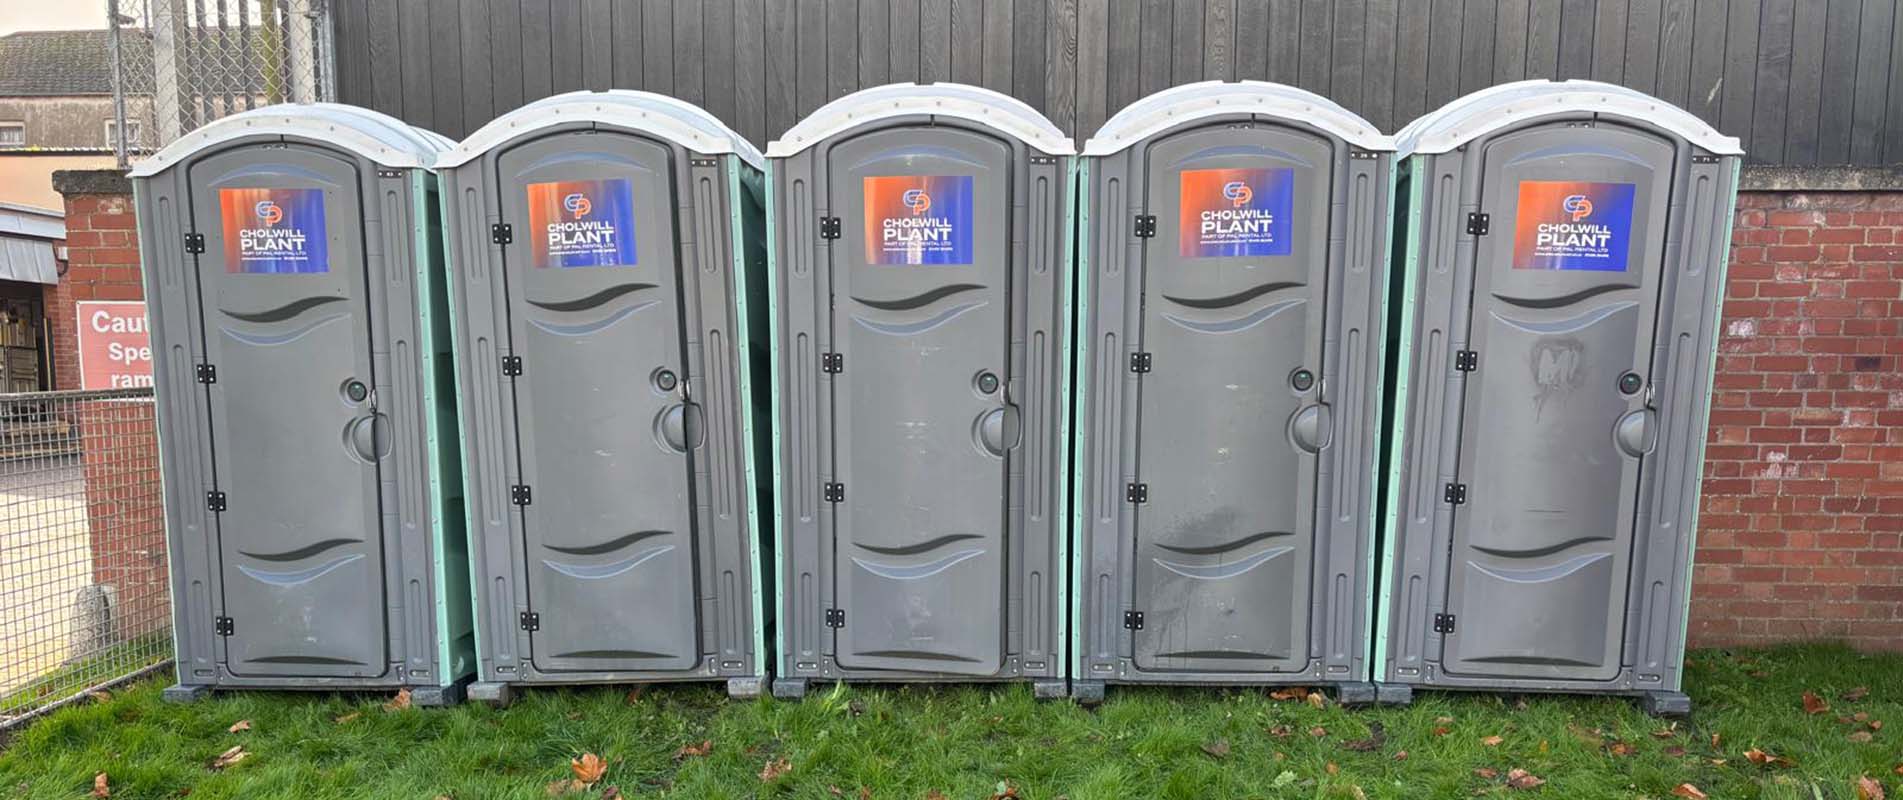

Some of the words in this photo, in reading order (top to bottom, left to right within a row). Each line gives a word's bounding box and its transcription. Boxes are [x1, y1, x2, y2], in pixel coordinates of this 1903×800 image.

[1201, 209, 1273, 220] CHOLWILL
[547, 221, 614, 233] CHOLWILL
[883, 217, 952, 228] CHOLWILL
[1201, 219, 1273, 234] PLANT
[1537, 223, 1611, 234] CHOLWILL
[240, 229, 305, 238] CHOLWILL
[548, 230, 614, 246] PLANT
[883, 228, 952, 241] PLANT
[241, 238, 306, 251] PLANT
[1536, 233, 1611, 247] PLANT
